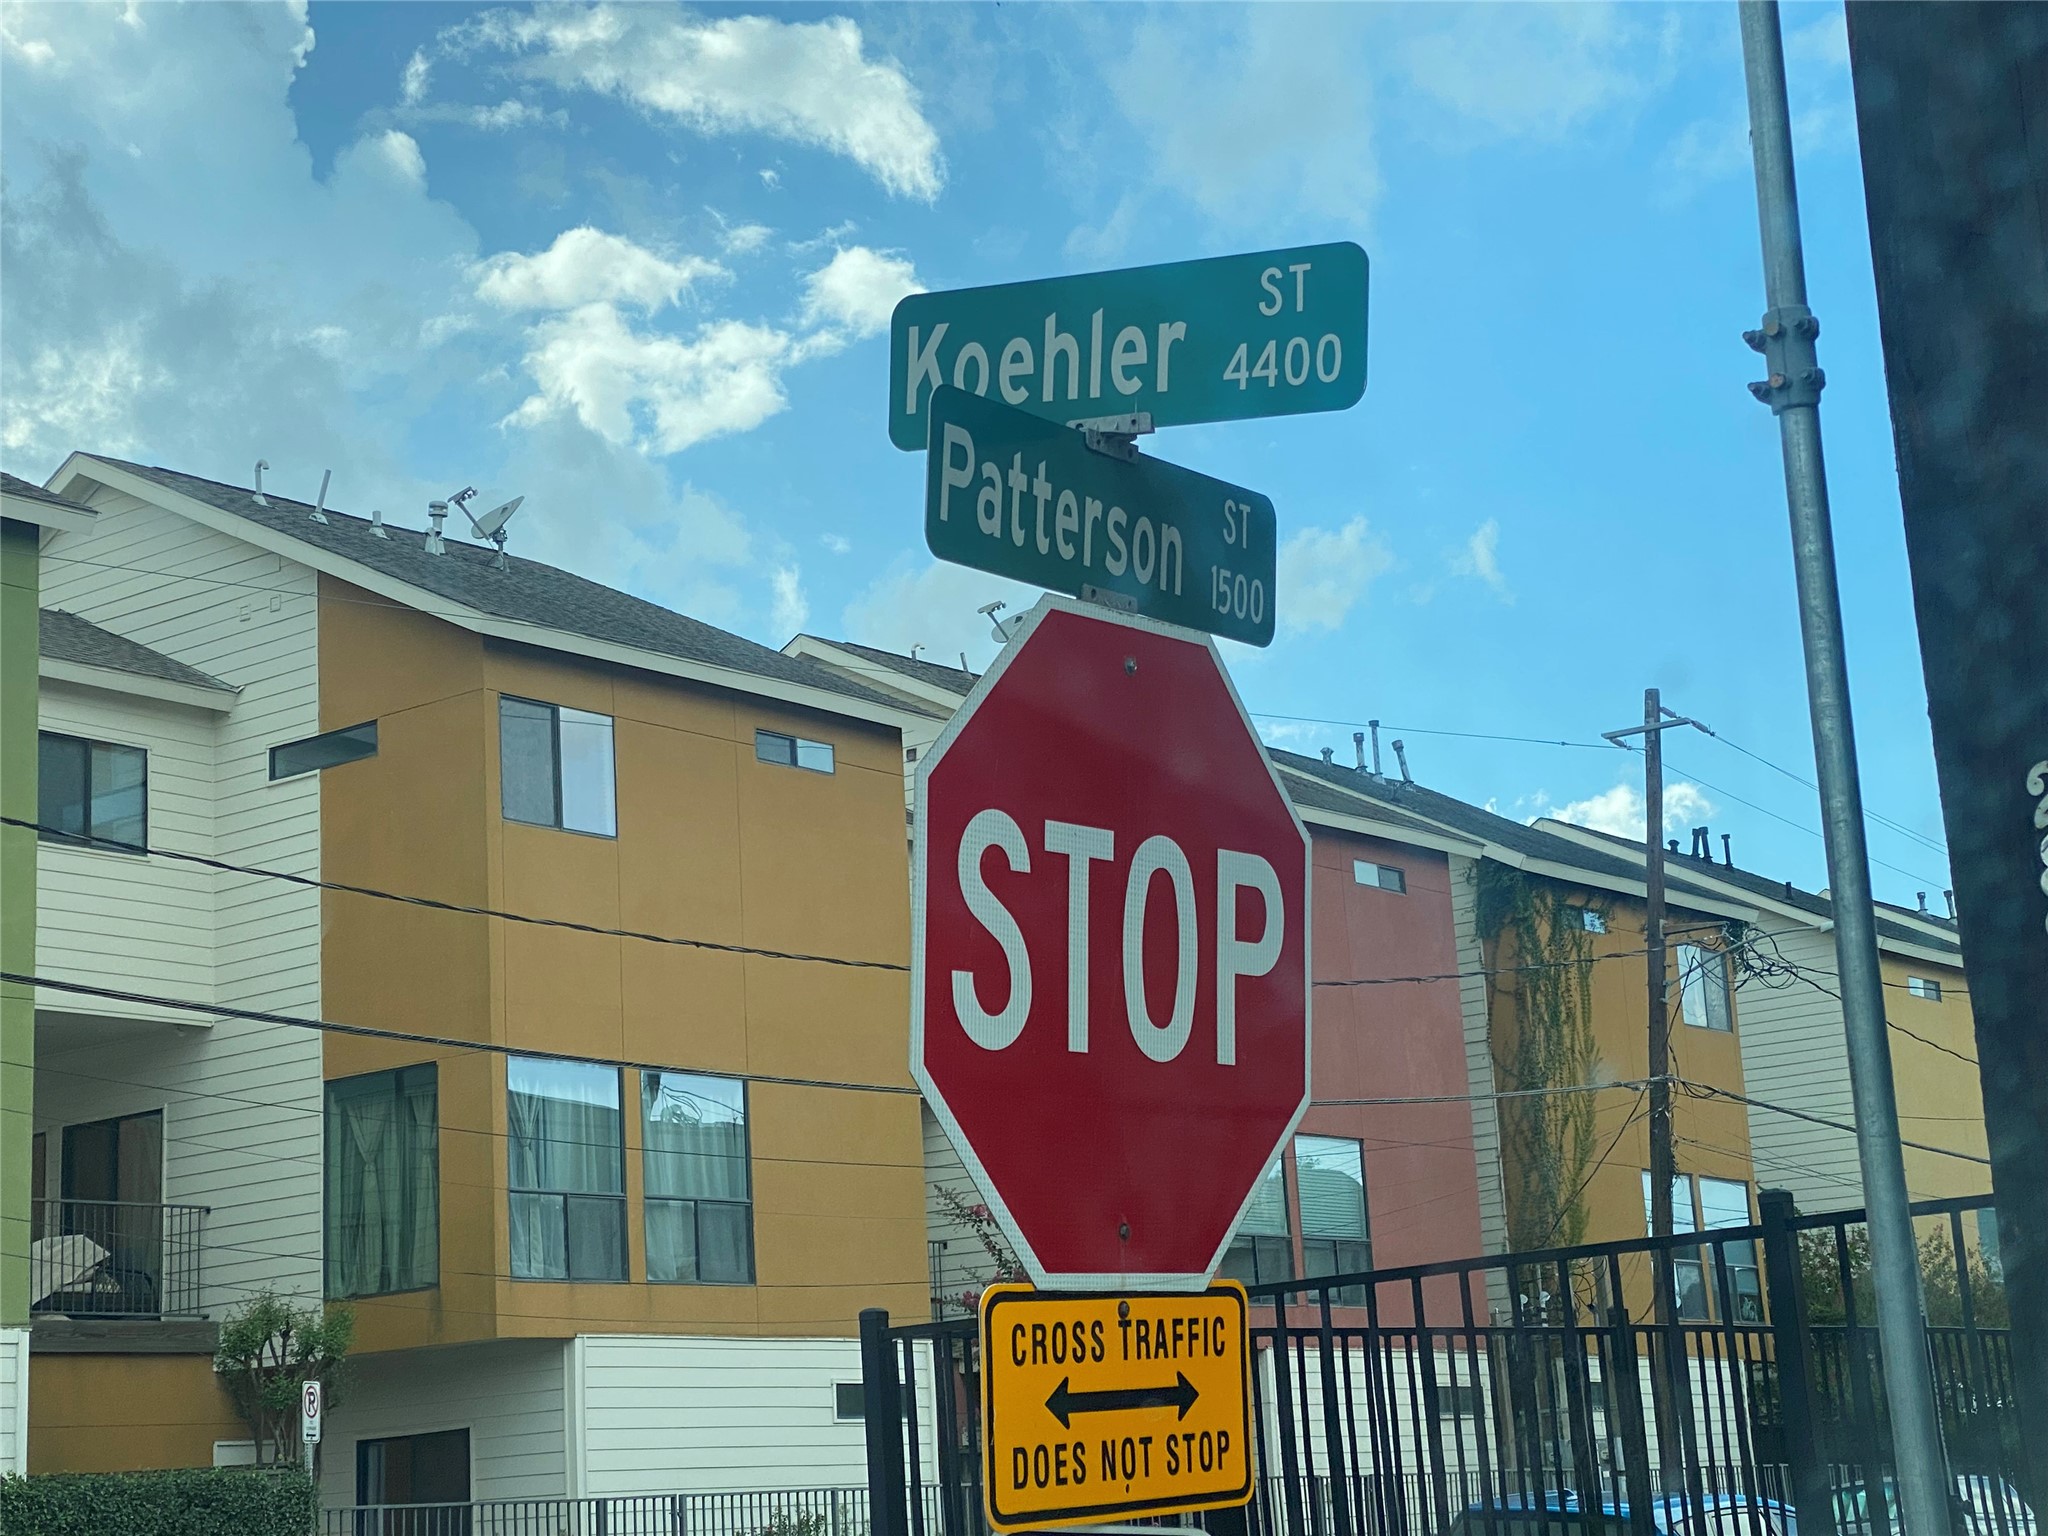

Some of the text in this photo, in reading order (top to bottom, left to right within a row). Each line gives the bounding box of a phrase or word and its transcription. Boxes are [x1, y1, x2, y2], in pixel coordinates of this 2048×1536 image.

[1258, 263, 1312, 316] ST
[905, 308, 1187, 415] Koehler
[1223, 333, 1342, 391] 4400
[940, 422, 1183, 596] Patterson
[1223, 499, 1251, 549] ST
[1211, 565, 1264, 625] 1500
[951, 808, 1285, 1066] STOP
[1011, 1316, 1226, 1367] CROSS TRAFFIC
[1012, 1430, 1230, 1490] DOES NOT STOP
